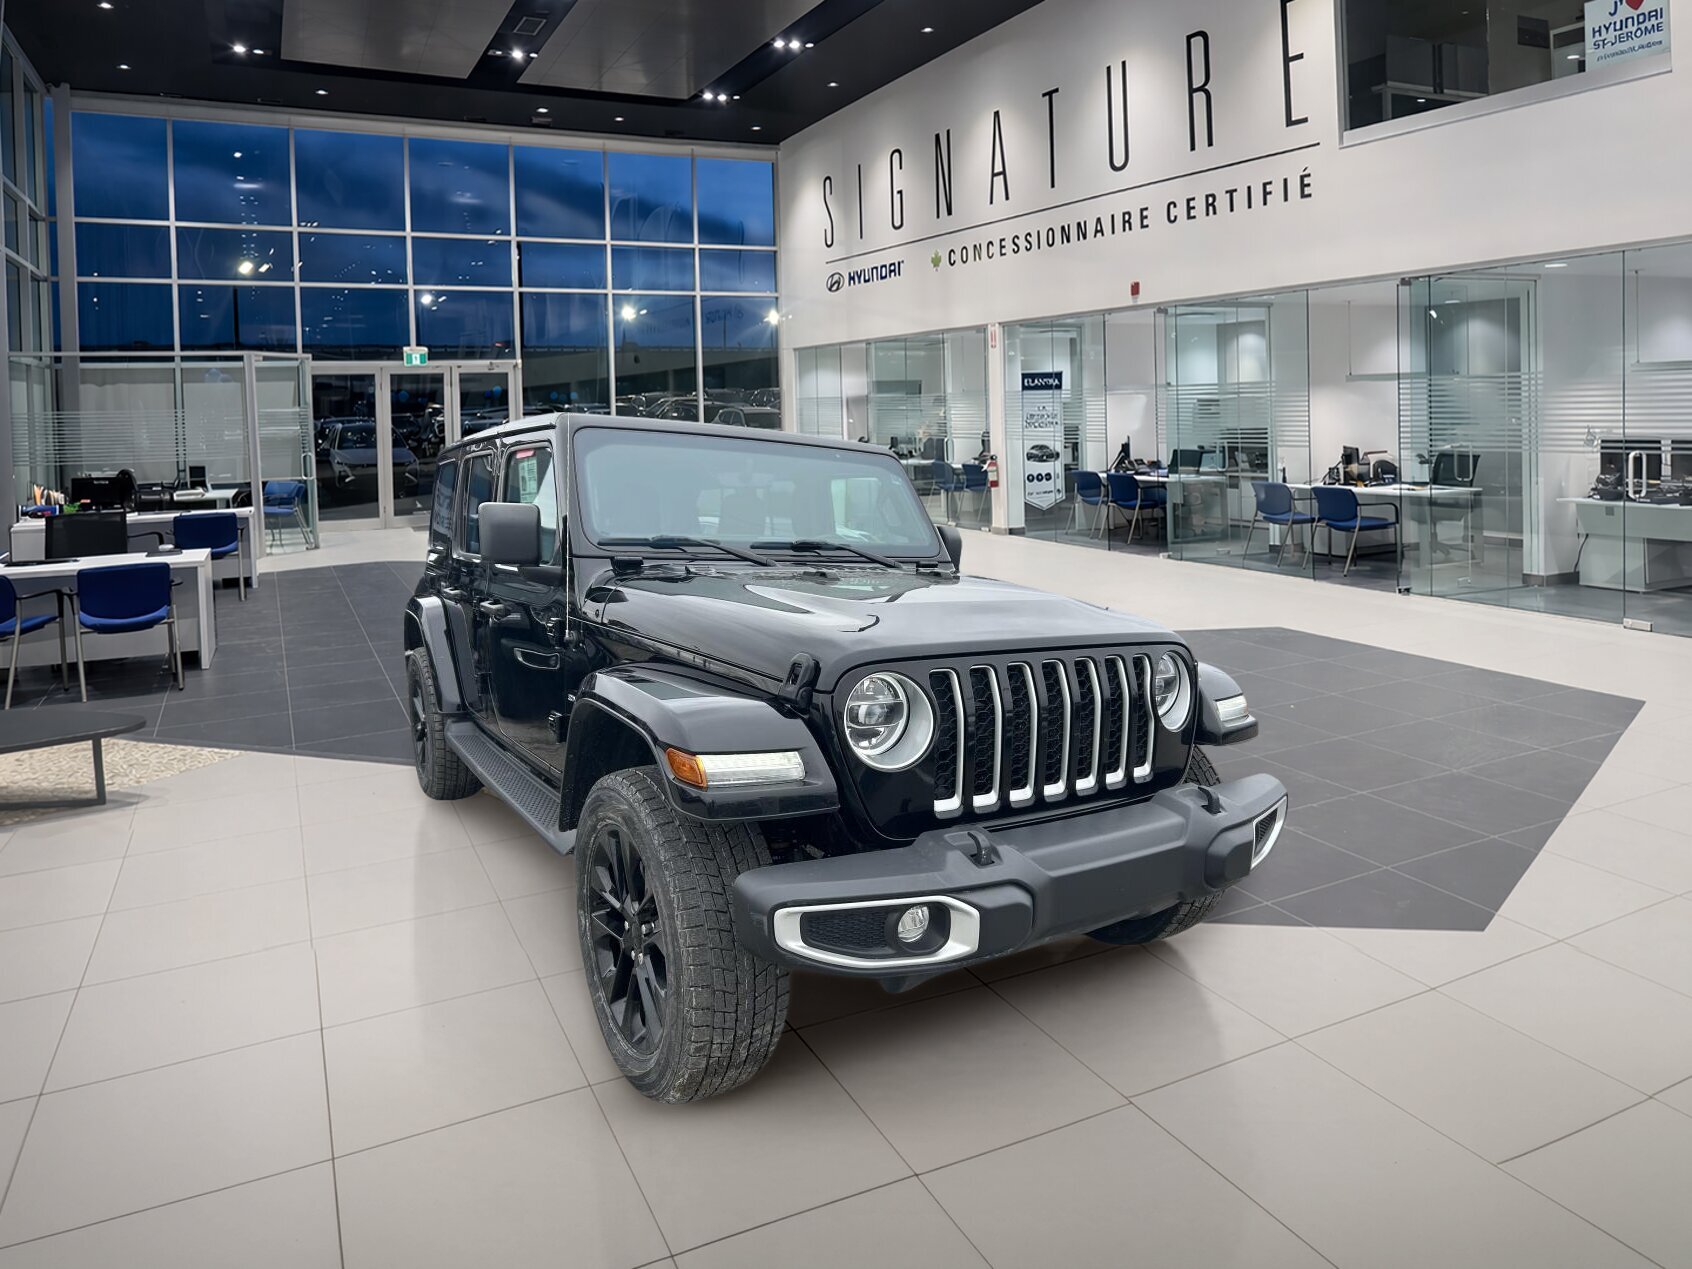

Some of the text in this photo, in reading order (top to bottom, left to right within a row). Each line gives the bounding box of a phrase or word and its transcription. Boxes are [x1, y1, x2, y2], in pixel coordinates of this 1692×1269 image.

[1592, 7, 1664, 39] HYUNDAI
[823, 0, 1309, 248] SIGNATURE
[948, 166, 1313, 267] CONCESSIONNAIRE CERTIFIÉ
[848, 260, 904, 287] HYUNDAI
